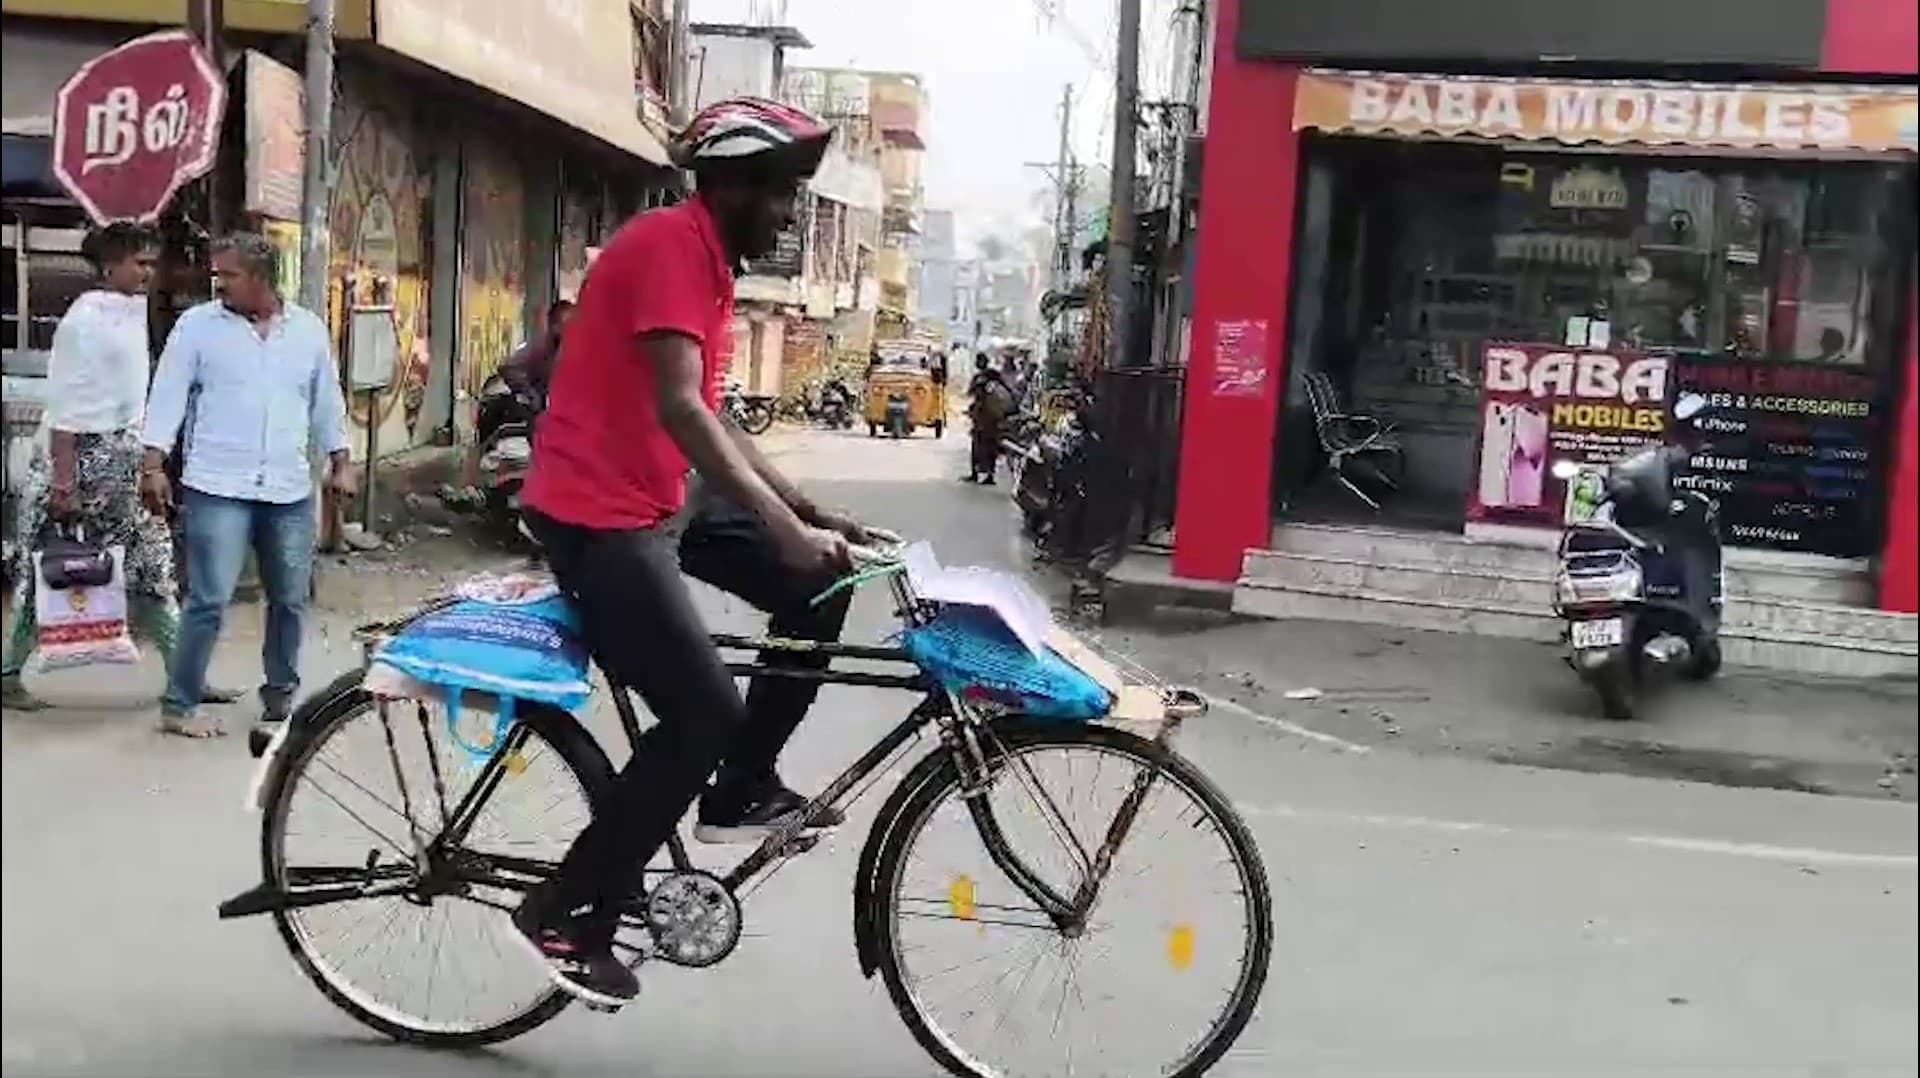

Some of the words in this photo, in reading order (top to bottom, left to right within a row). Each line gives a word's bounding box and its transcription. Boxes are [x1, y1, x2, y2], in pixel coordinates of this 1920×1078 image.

[82, 84, 188, 176] நில்
[1350, 77, 1522, 130] BABA
[1544, 86, 1851, 140] MOBILES
[1486, 349, 1668, 404] BABA
[1552, 403, 1665, 432] MOBILES
[1751, 397, 1870, 417] ACCESSORIES
